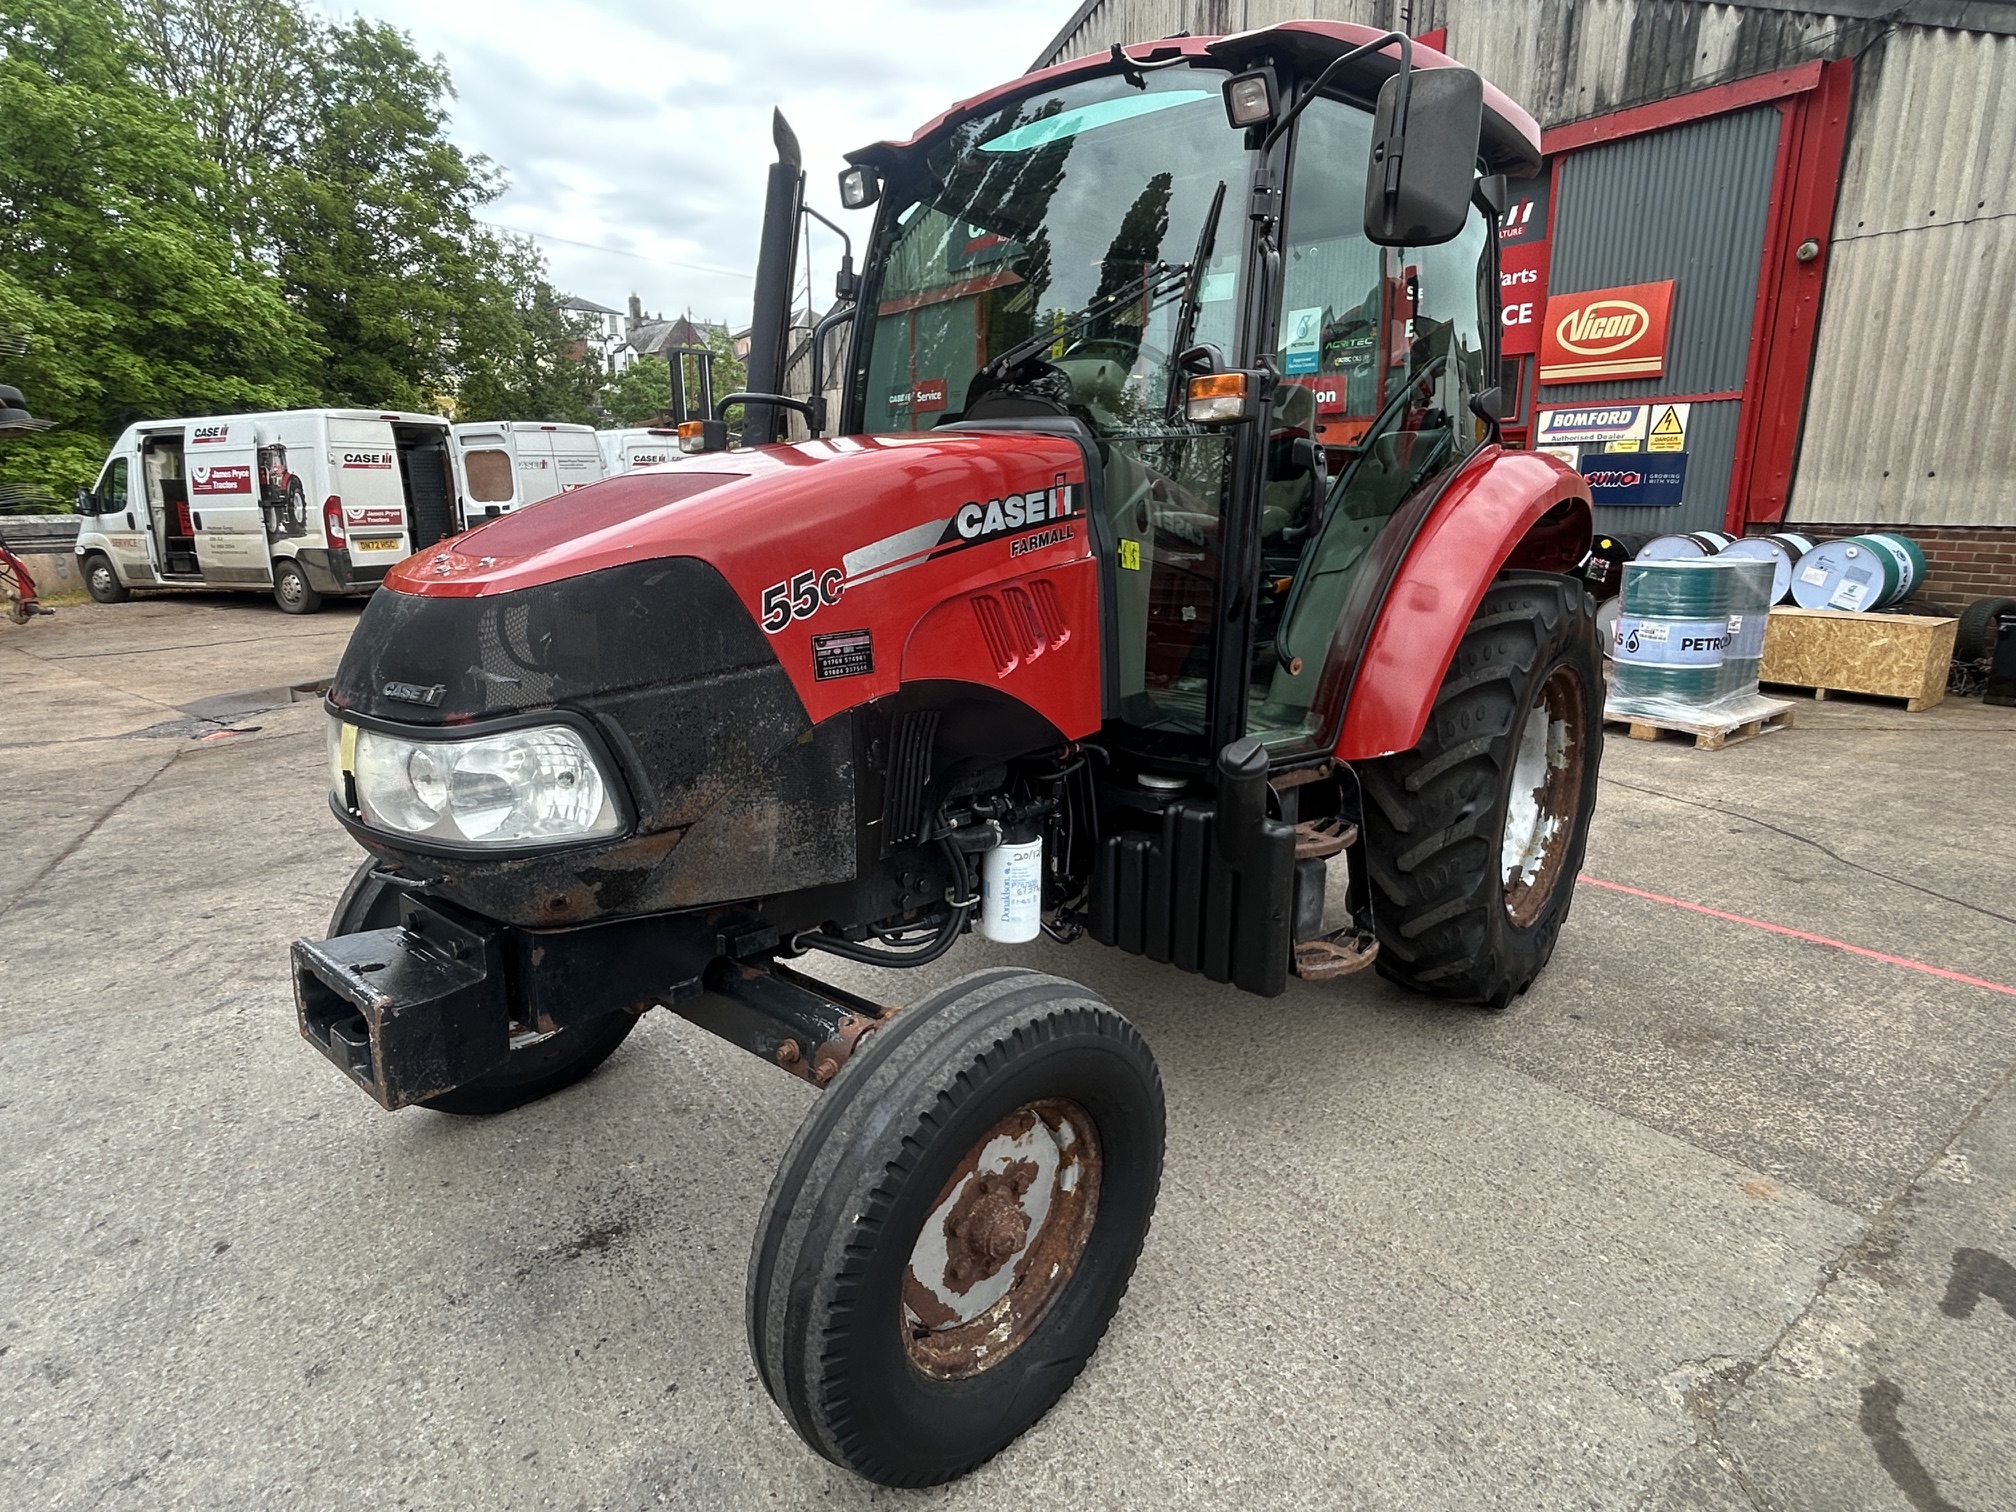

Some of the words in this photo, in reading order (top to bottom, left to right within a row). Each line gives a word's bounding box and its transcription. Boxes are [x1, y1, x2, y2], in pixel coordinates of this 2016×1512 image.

[1500, 268, 1538, 286] arts
[1568, 308, 1638, 342] Vicon
[917, 390, 942, 402] Service
[1553, 411, 1632, 427] BOMFORD
[194, 427, 219, 437] CASE
[1551, 433, 1594, 441] Authorised
[344, 453, 380, 463] CASE
[518, 461, 538, 470] ASE
[212, 470, 231, 478] James
[1586, 471, 1638, 487] SUMO
[213, 481, 238, 489] Tractors
[957, 491, 1046, 539] CASE
[112, 538, 138, 547] SERVICE
[1010, 525, 1074, 558] FARMALL
[760, 567, 845, 635] 55C
[383, 682, 421, 699] CASE
